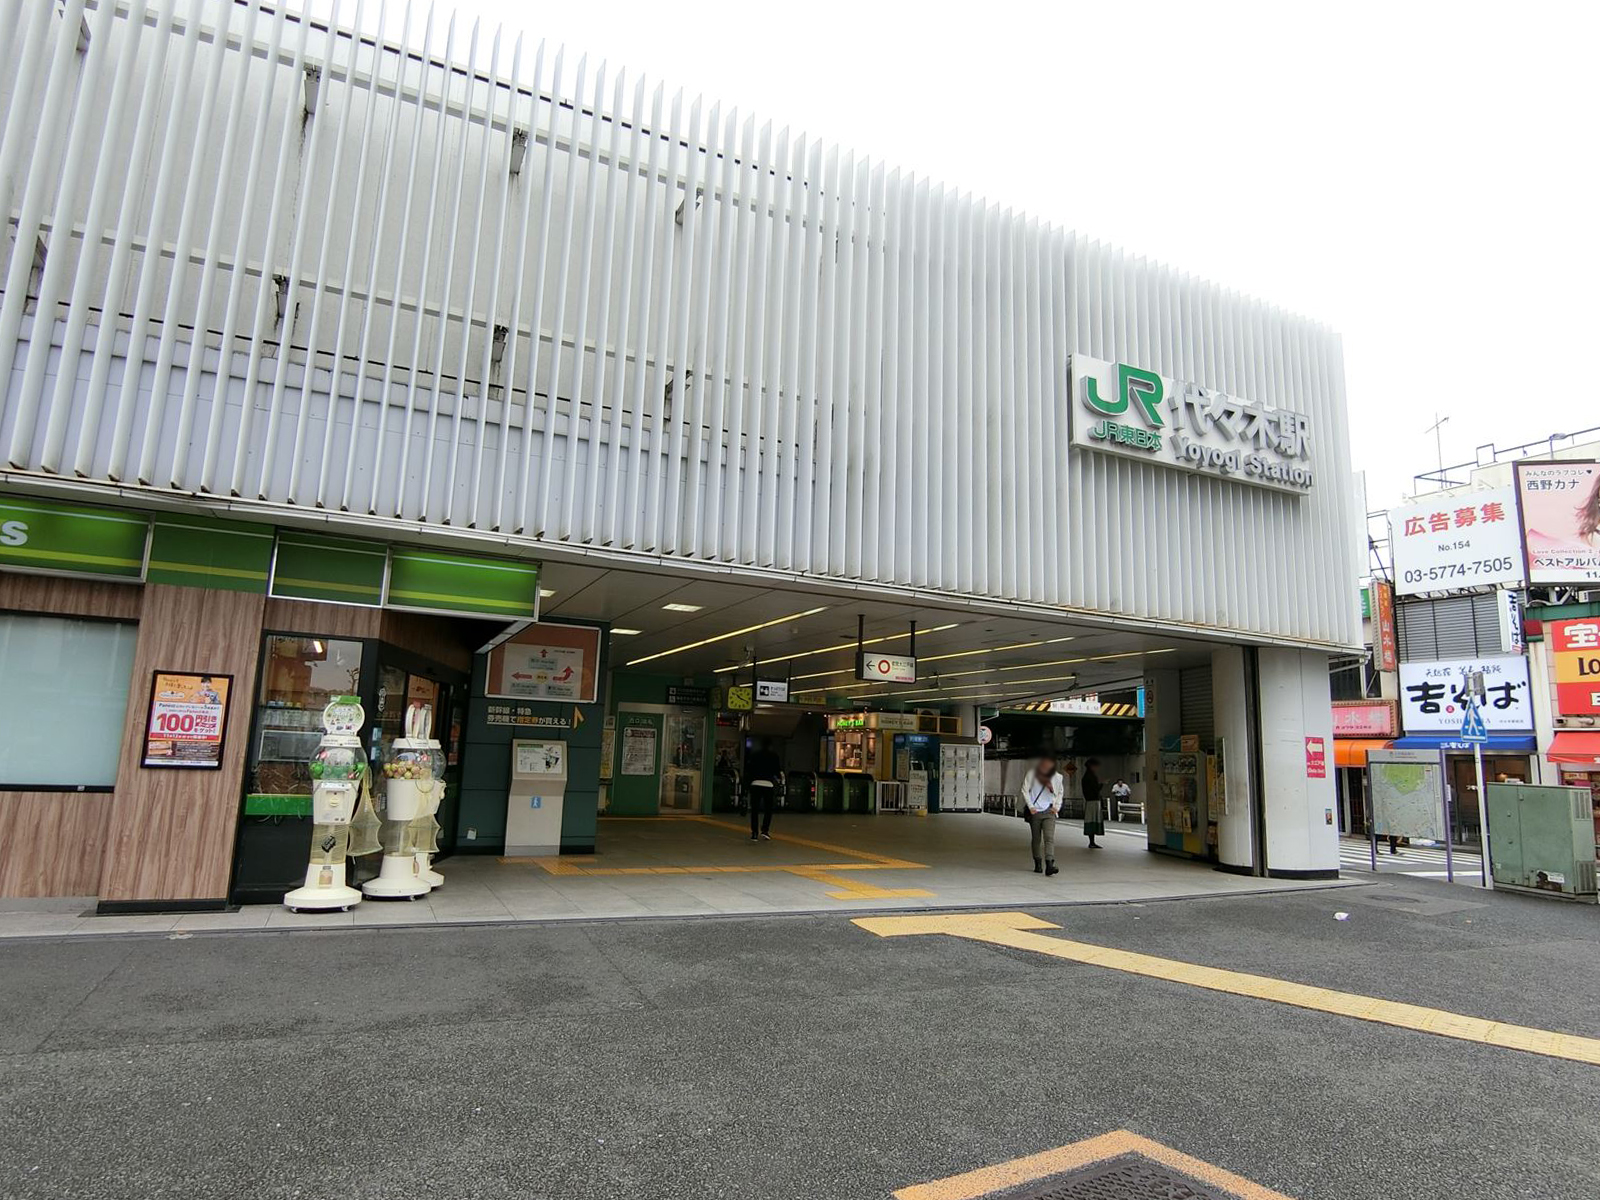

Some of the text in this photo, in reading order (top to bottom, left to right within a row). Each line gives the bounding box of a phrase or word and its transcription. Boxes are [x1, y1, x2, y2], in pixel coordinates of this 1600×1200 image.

[1081, 362, 1165, 428] JR
[1168, 380, 1310, 461] 代々木駅
[1089, 420, 1162, 452] JR東日本
[1170, 434, 1314, 488] Yoyogi Station
[1527, 478, 1580, 491] 西野カナ
[1404, 502, 1505, 537] 広告募集
[1437, 540, 1470, 552] No.154
[1404, 556, 1513, 584] 03-5774-7505
[1534, 557, 1600, 567] ベストアルバ
[156, 713, 195, 732] 100
[487, 705, 532, 716] 新幹線・特急
